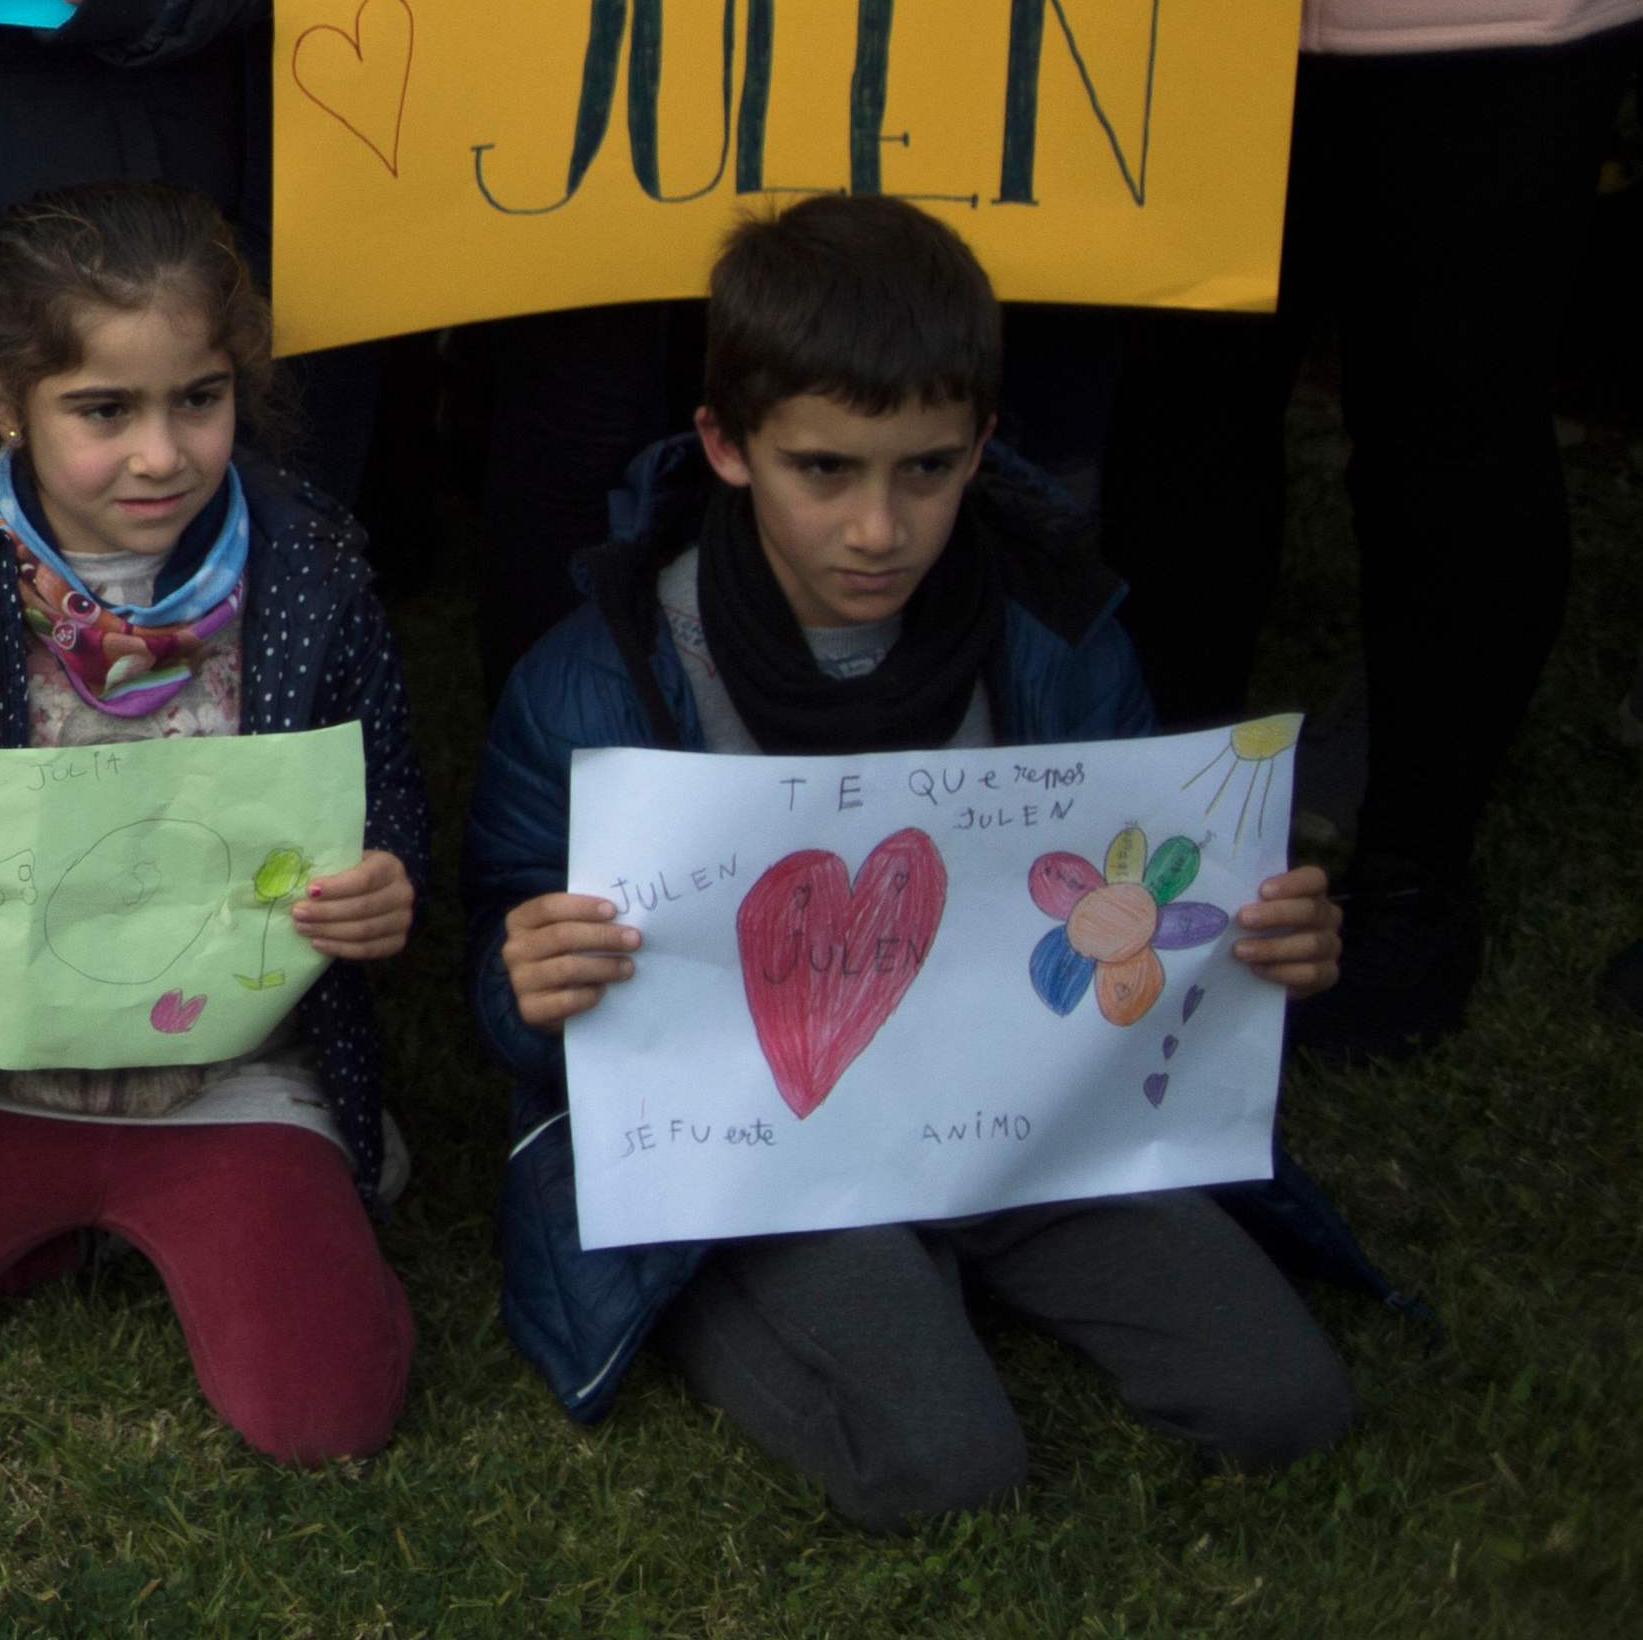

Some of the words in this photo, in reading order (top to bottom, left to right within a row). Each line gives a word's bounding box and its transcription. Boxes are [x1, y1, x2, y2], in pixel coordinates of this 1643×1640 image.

[954, 799, 1074, 830] JULEN
[611, 854, 738, 916] JULEN
[762, 931, 927, 987] JULEN
